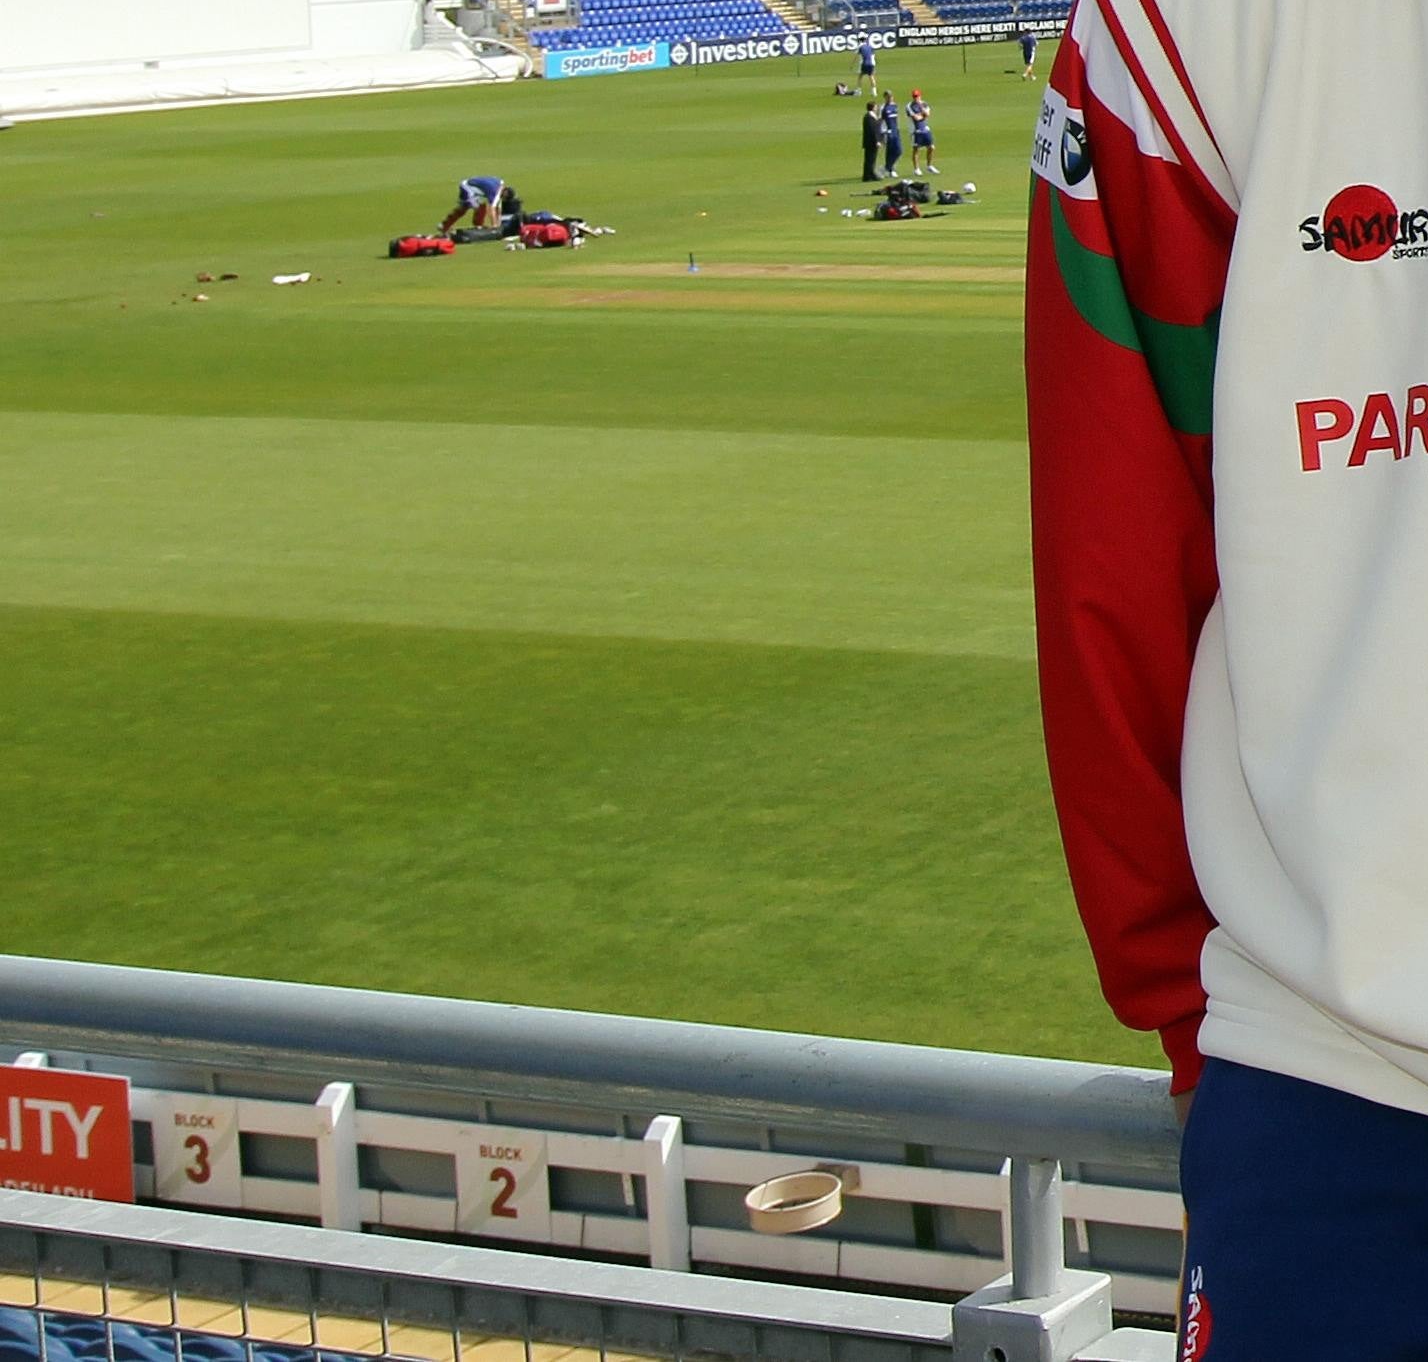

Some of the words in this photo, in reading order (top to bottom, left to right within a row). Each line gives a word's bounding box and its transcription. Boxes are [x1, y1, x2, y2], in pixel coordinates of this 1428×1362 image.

[899, 27, 938, 38] ENGLAND
[563, 48, 654, 73] sportingbet
[691, 36, 781, 64] Investec
[175, 1112, 215, 1129] BLOCK
[184, 1134, 211, 1184] 3
[480, 1144, 522, 1161] BLOCK
[490, 1167, 518, 1219] 2
